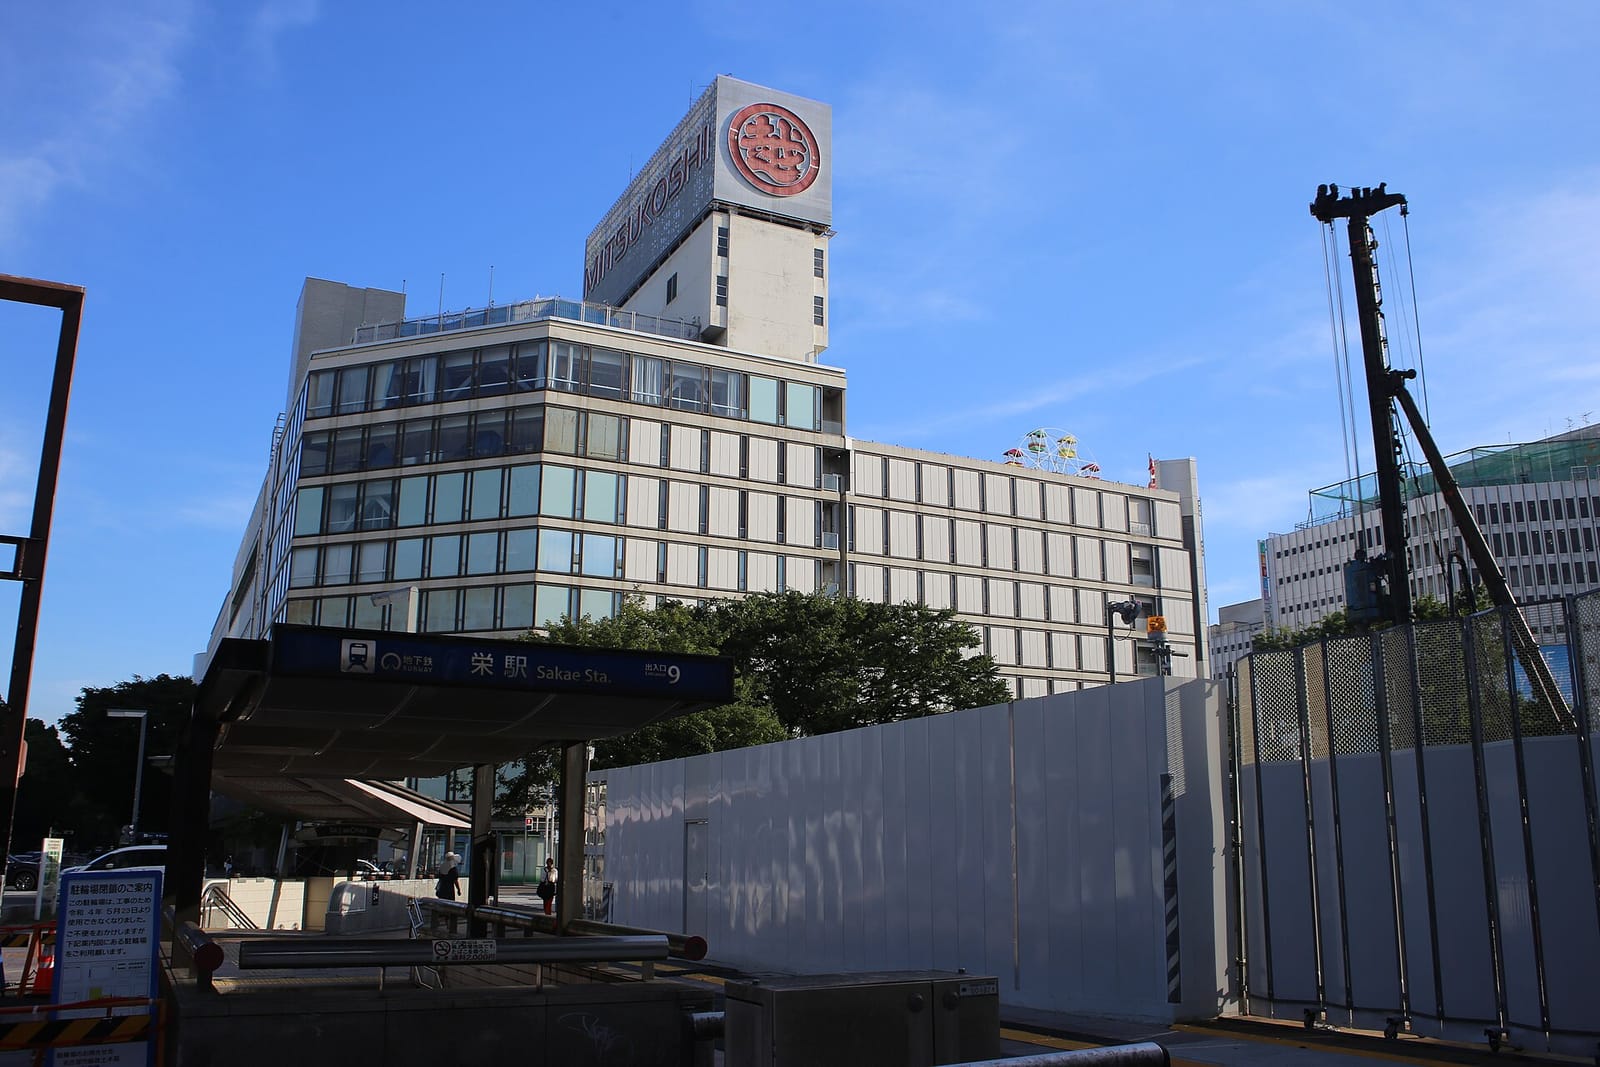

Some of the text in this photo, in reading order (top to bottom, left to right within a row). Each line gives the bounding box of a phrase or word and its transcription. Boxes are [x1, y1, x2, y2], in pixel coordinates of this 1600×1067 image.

[584, 126, 710, 298] MITSUKOSHI
[402, 655, 433, 666] 地下鉄
[471, 652, 528, 679] 栄駅
[535, 665, 612, 684] Sakae Sta.
[644, 663, 681, 685] 出入口 9
